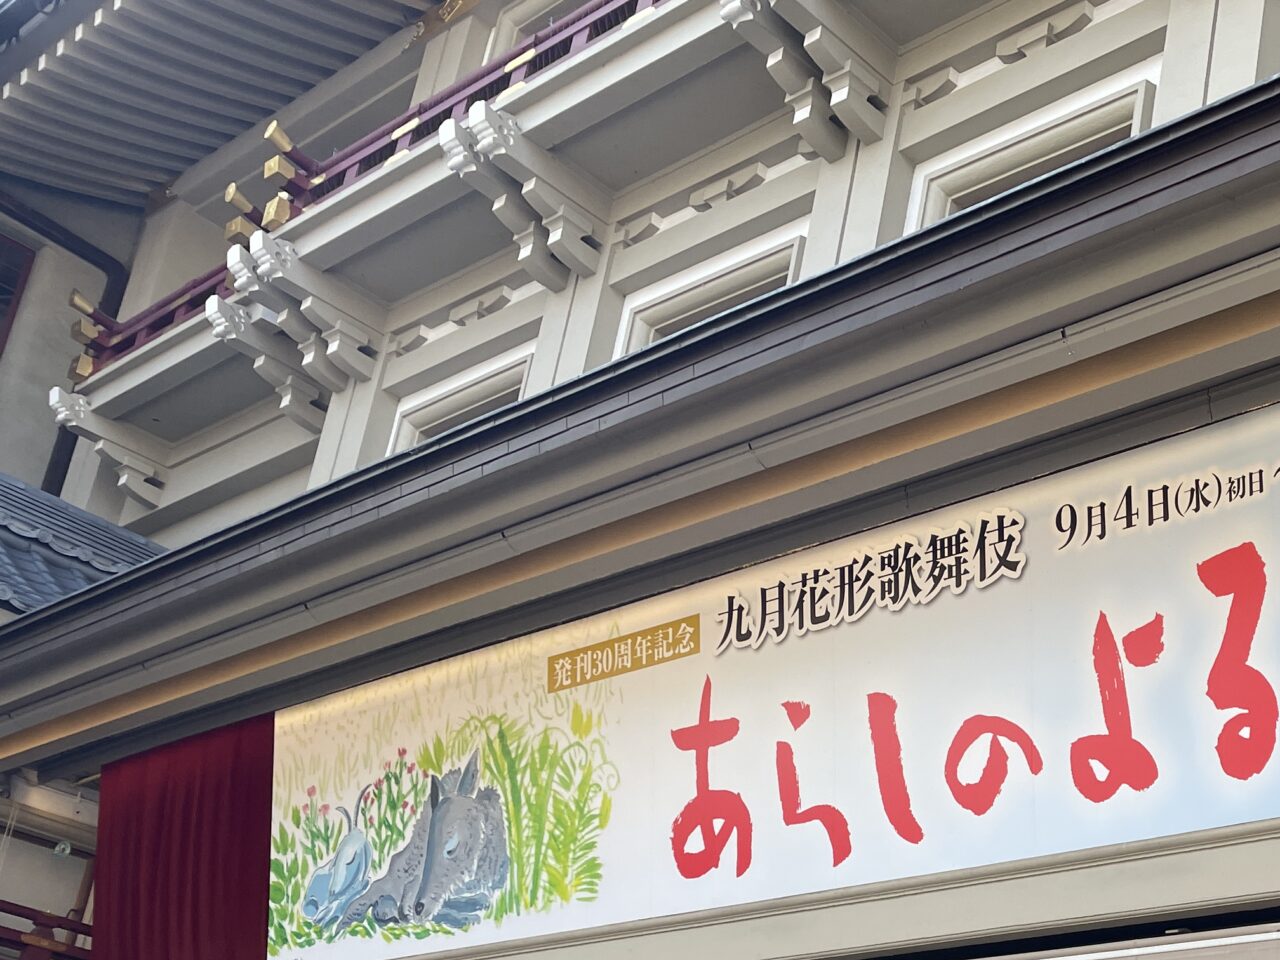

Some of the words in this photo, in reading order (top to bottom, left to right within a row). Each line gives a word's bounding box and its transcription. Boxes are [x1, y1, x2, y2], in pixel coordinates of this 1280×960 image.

[716, 513, 1022, 652] 九月花形歌舞伎
[552, 624, 695, 691] 発刊30周年記念
